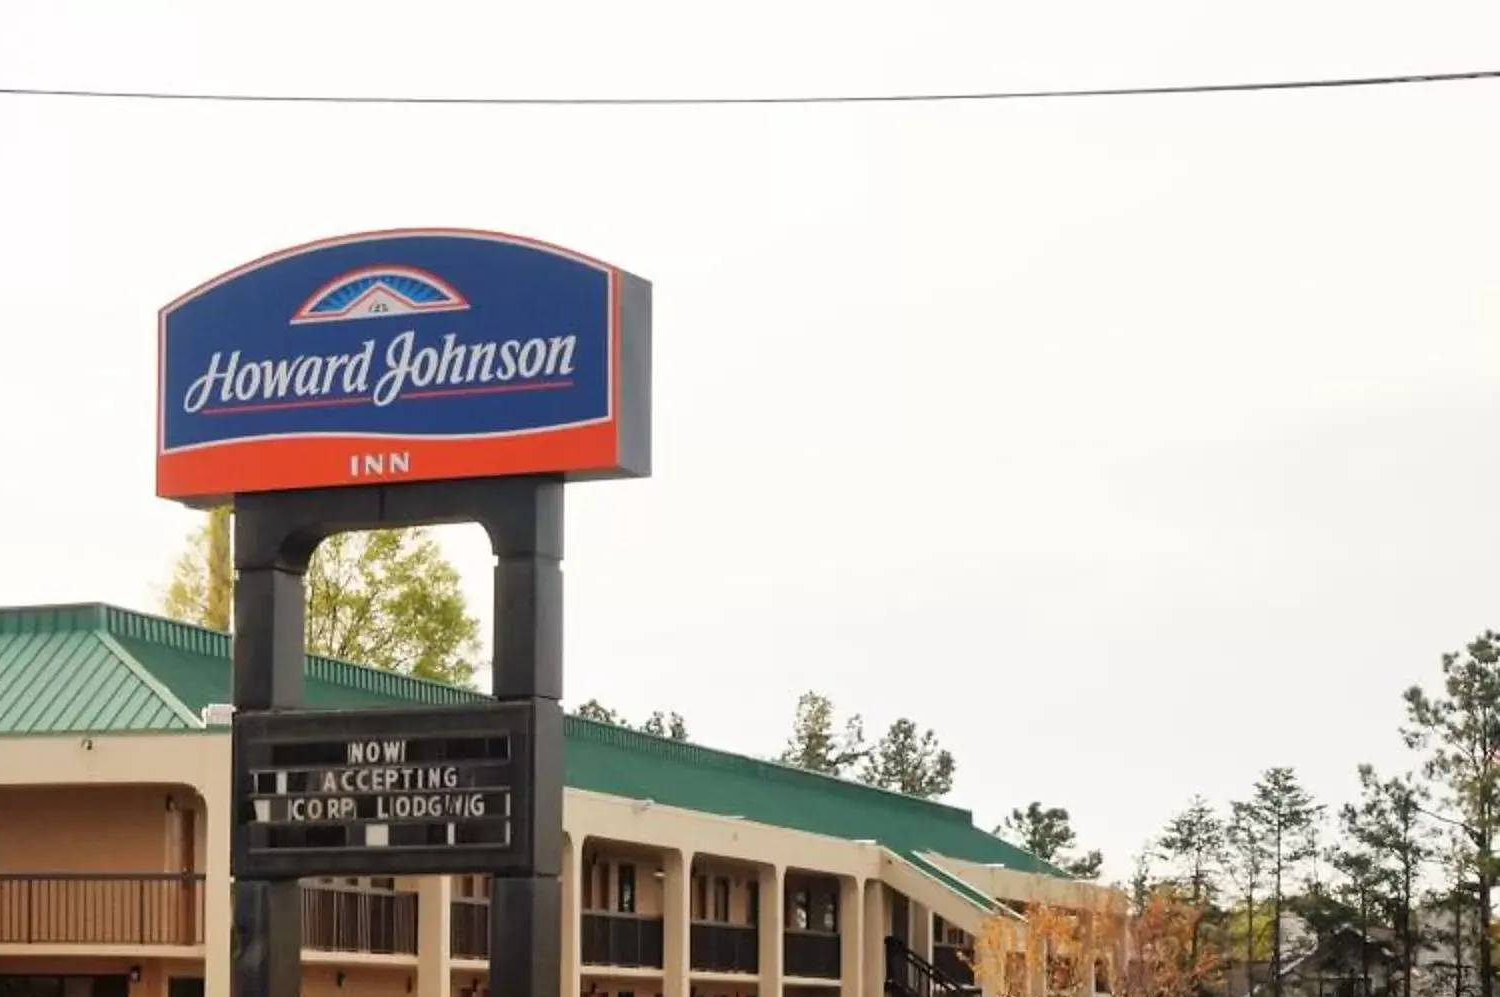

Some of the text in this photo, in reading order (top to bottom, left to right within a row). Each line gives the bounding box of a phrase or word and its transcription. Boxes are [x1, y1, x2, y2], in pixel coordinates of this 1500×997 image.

[183, 329, 578, 414] Howard Johnson
[350, 451, 410, 476] INN
[349, 741, 402, 764] NOW
[323, 767, 457, 791] ACCEPTING
